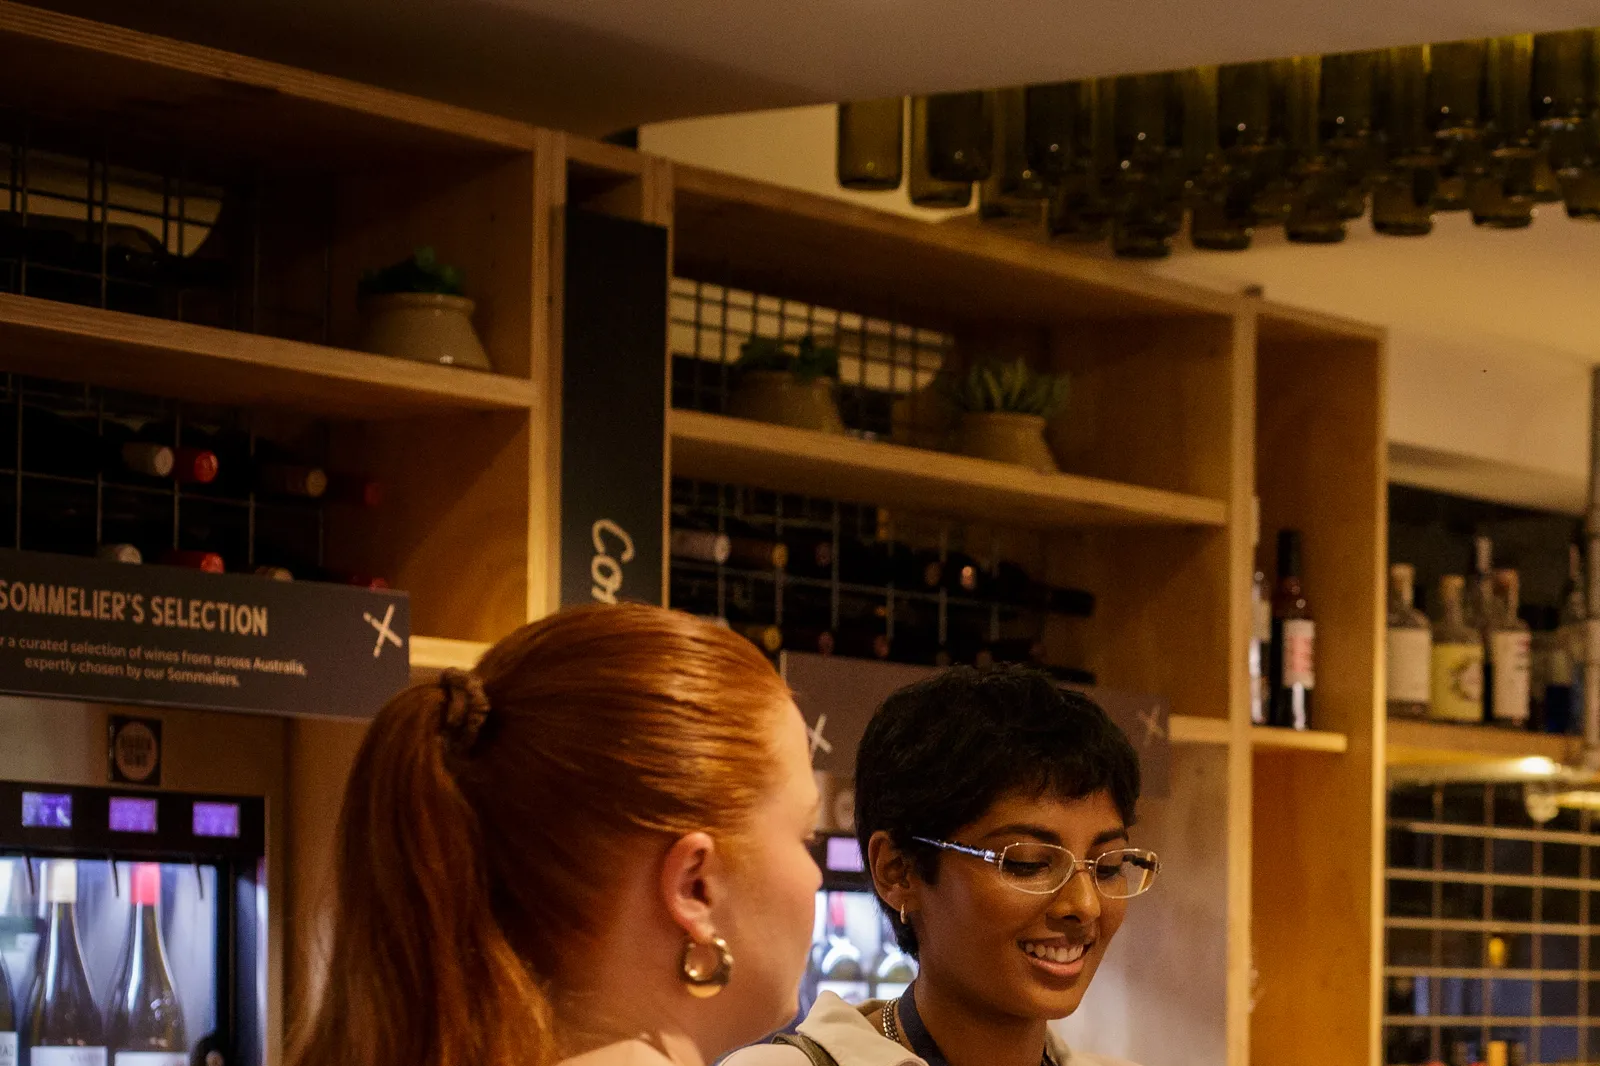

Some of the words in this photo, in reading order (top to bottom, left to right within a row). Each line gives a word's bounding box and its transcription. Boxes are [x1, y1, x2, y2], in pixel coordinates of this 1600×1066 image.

[0, 579, 145, 625] SOMMELIER'S
[150, 595, 269, 637] SELECTION
[8, 638, 16, 647] a
[19, 637, 68, 653] curated
[70, 641, 126, 658] selection
[129, 646, 142, 660] of
[143, 648, 179, 663] wines
[182, 650, 212, 667] from
[214, 655, 251, 671] across
[24, 657, 76, 675] expertly
[79, 660, 124, 677] chosen
[126, 663, 142, 681] by
[144, 668, 165, 681] our
